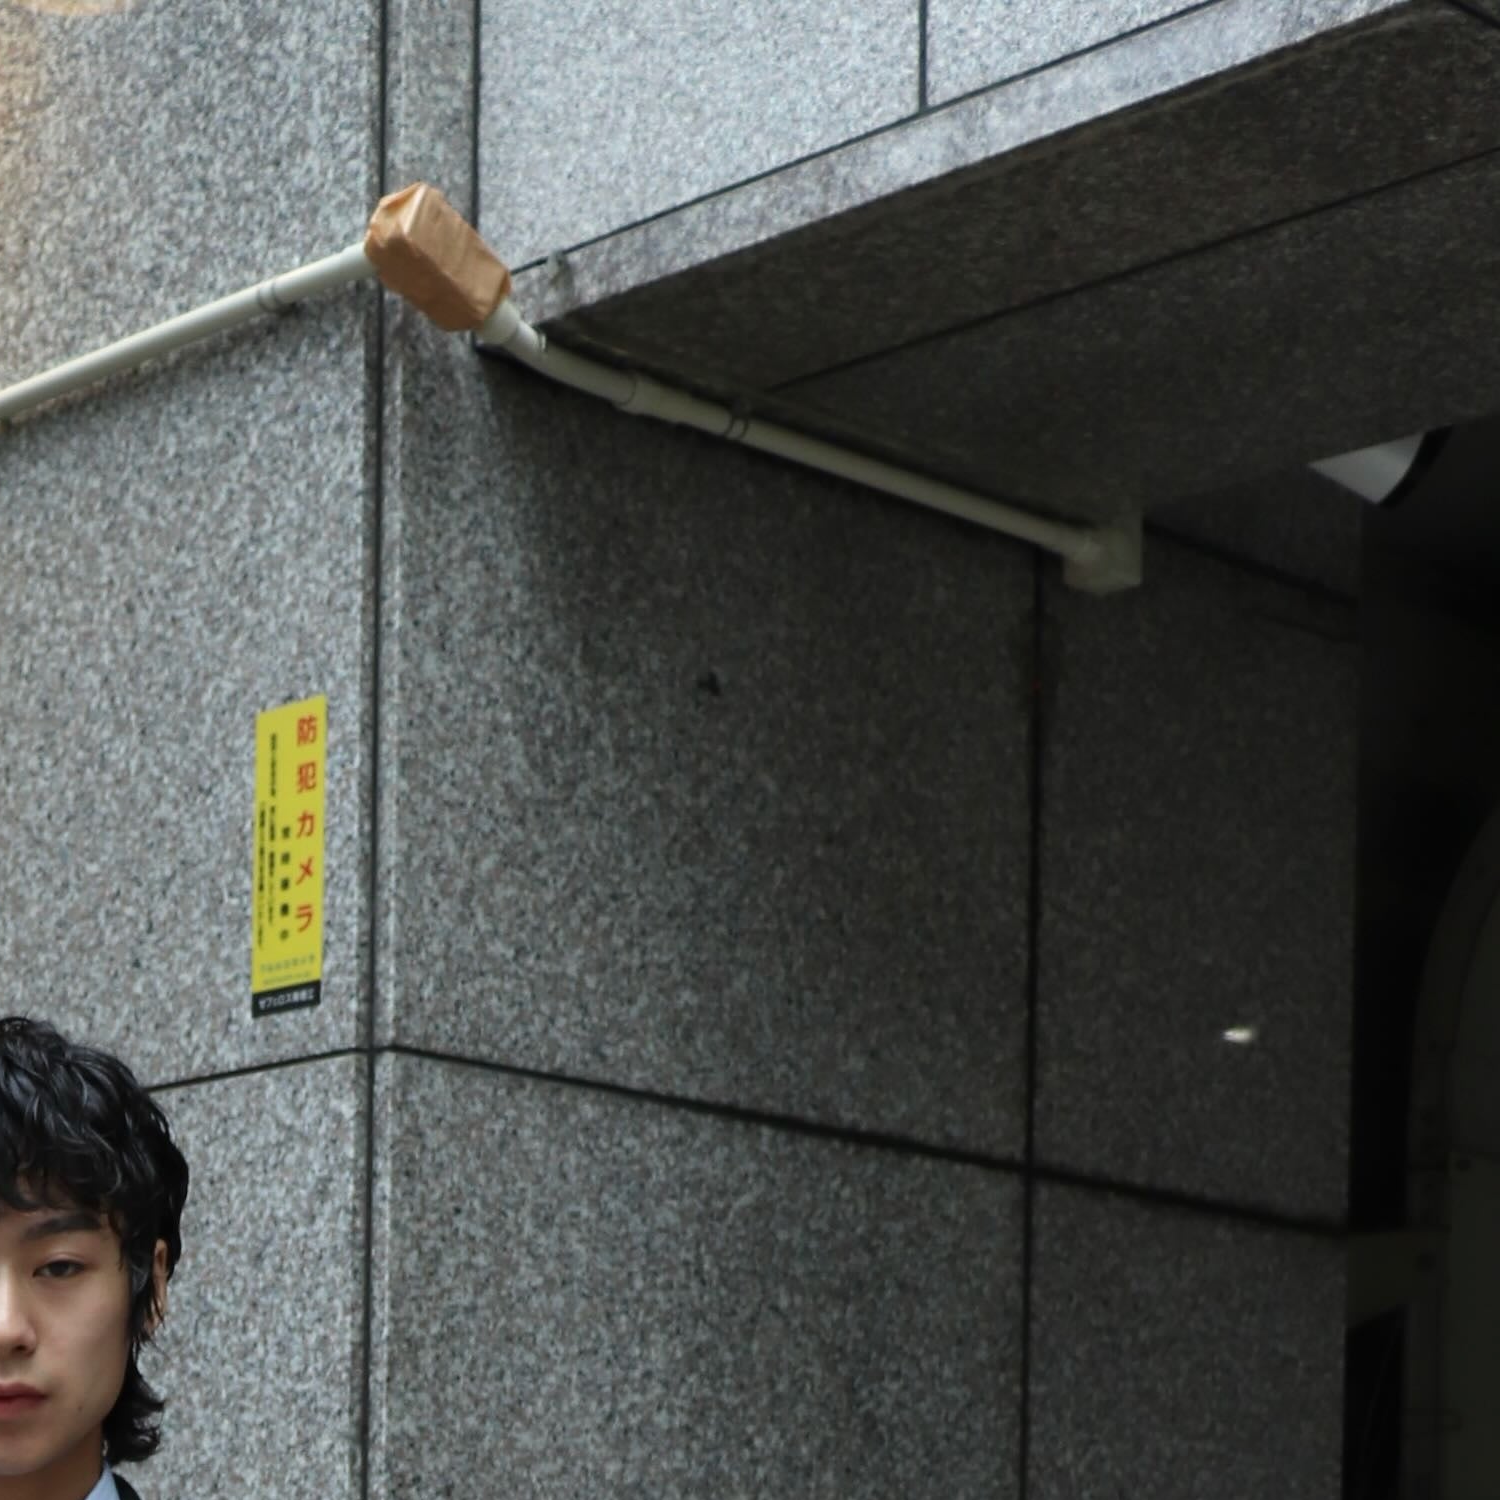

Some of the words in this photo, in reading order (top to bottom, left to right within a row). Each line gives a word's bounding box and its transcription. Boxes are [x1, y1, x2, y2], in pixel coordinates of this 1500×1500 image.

[295, 714, 318, 933] 防犯カメラ
